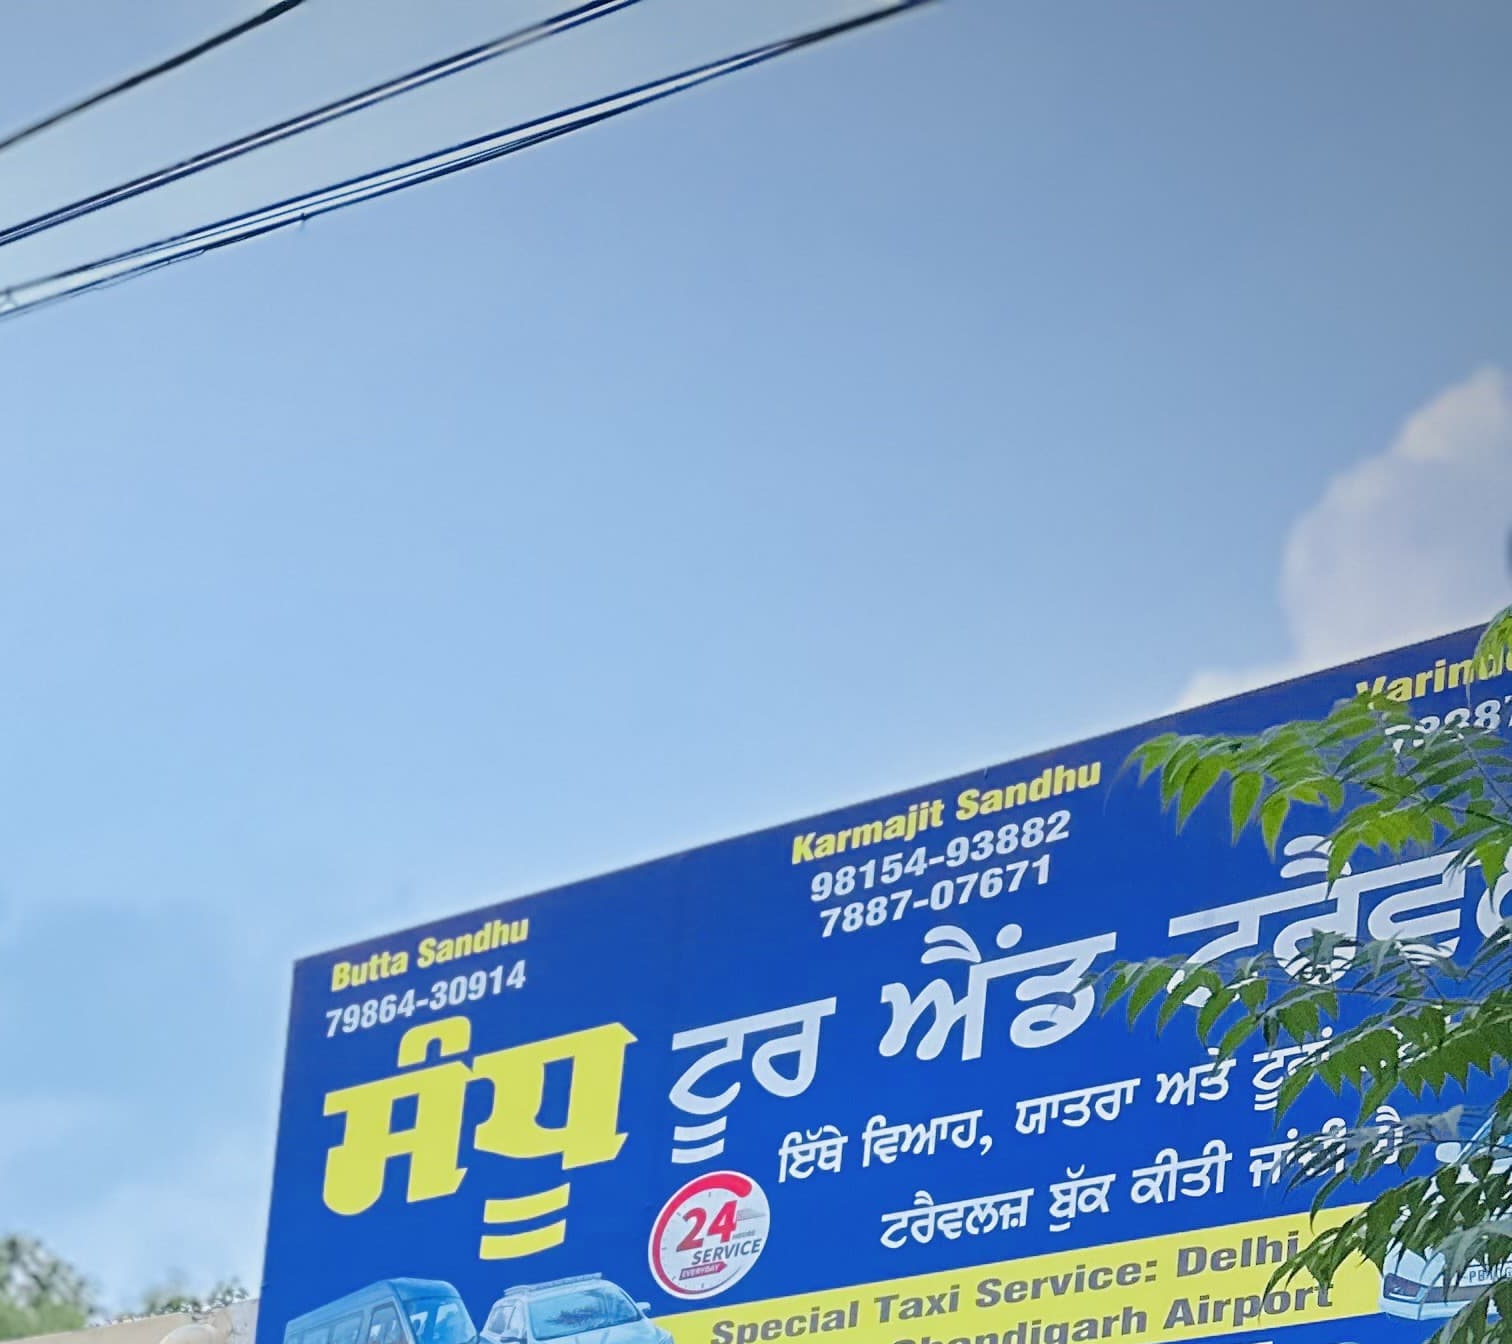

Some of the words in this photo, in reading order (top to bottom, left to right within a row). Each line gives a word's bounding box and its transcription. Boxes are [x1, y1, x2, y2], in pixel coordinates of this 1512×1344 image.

[791, 799, 944, 866] Karmajit
[956, 760, 1102, 820] Sandhu
[810, 809, 1071, 903] 98154-93882
[819, 853, 1052, 938] 7887-07671
[331, 951, 408, 993] Butta
[417, 918, 529, 968] Sandhu
[324, 960, 526, 1038] 79864-30914
[322, 1015, 639, 1261] ਸੰਧੂ
[668, 996, 837, 1163] ਟੂਰ
[878, 925, 1116, 1062] ਐਂਡ
[778, 1124, 848, 1183] ਇੱਥੇ
[862, 1109, 993, 1167] ਵਿਆਹ,
[1014, 1077, 1141, 1135] ਯਾਤਰਾ
[1155, 1047, 1237, 1106] ਅਤੇ
[676, 1199, 738, 1252] 24
[879, 1190, 1034, 1249] ਟਰੈਵਲਜ਼
[1049, 1164, 1116, 1232] ਬੁੱਕ
[1130, 1139, 1232, 1204] ਕੀਤੀ
[682, 1263, 719, 1278] EVERYDAY
[691, 1238, 762, 1266] SERVICE
[873, 1284, 961, 1324] Taxi
[975, 1260, 1158, 1308] Service:
[1163, 1284, 1334, 1331] Airport
